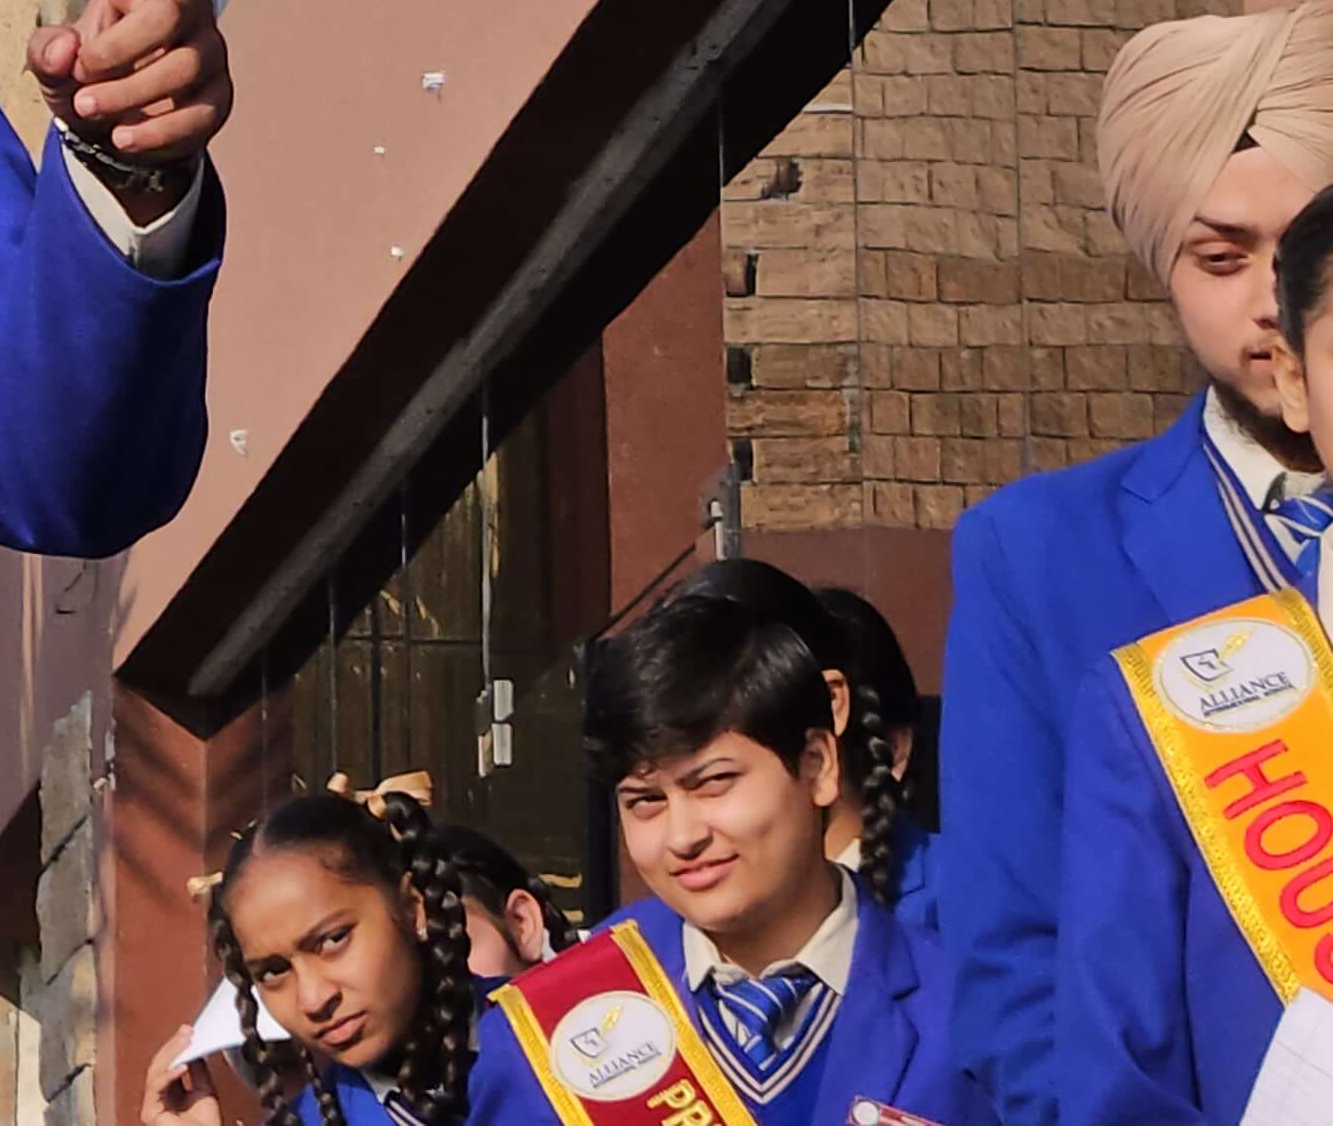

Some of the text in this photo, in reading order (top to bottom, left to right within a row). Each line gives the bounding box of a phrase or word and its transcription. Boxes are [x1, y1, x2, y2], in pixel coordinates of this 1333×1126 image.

[1199, 671, 1292, 711] ALLIANCE
[588, 1040, 659, 1083] ALLIANCE
[646, 1077, 725, 1126] PR
